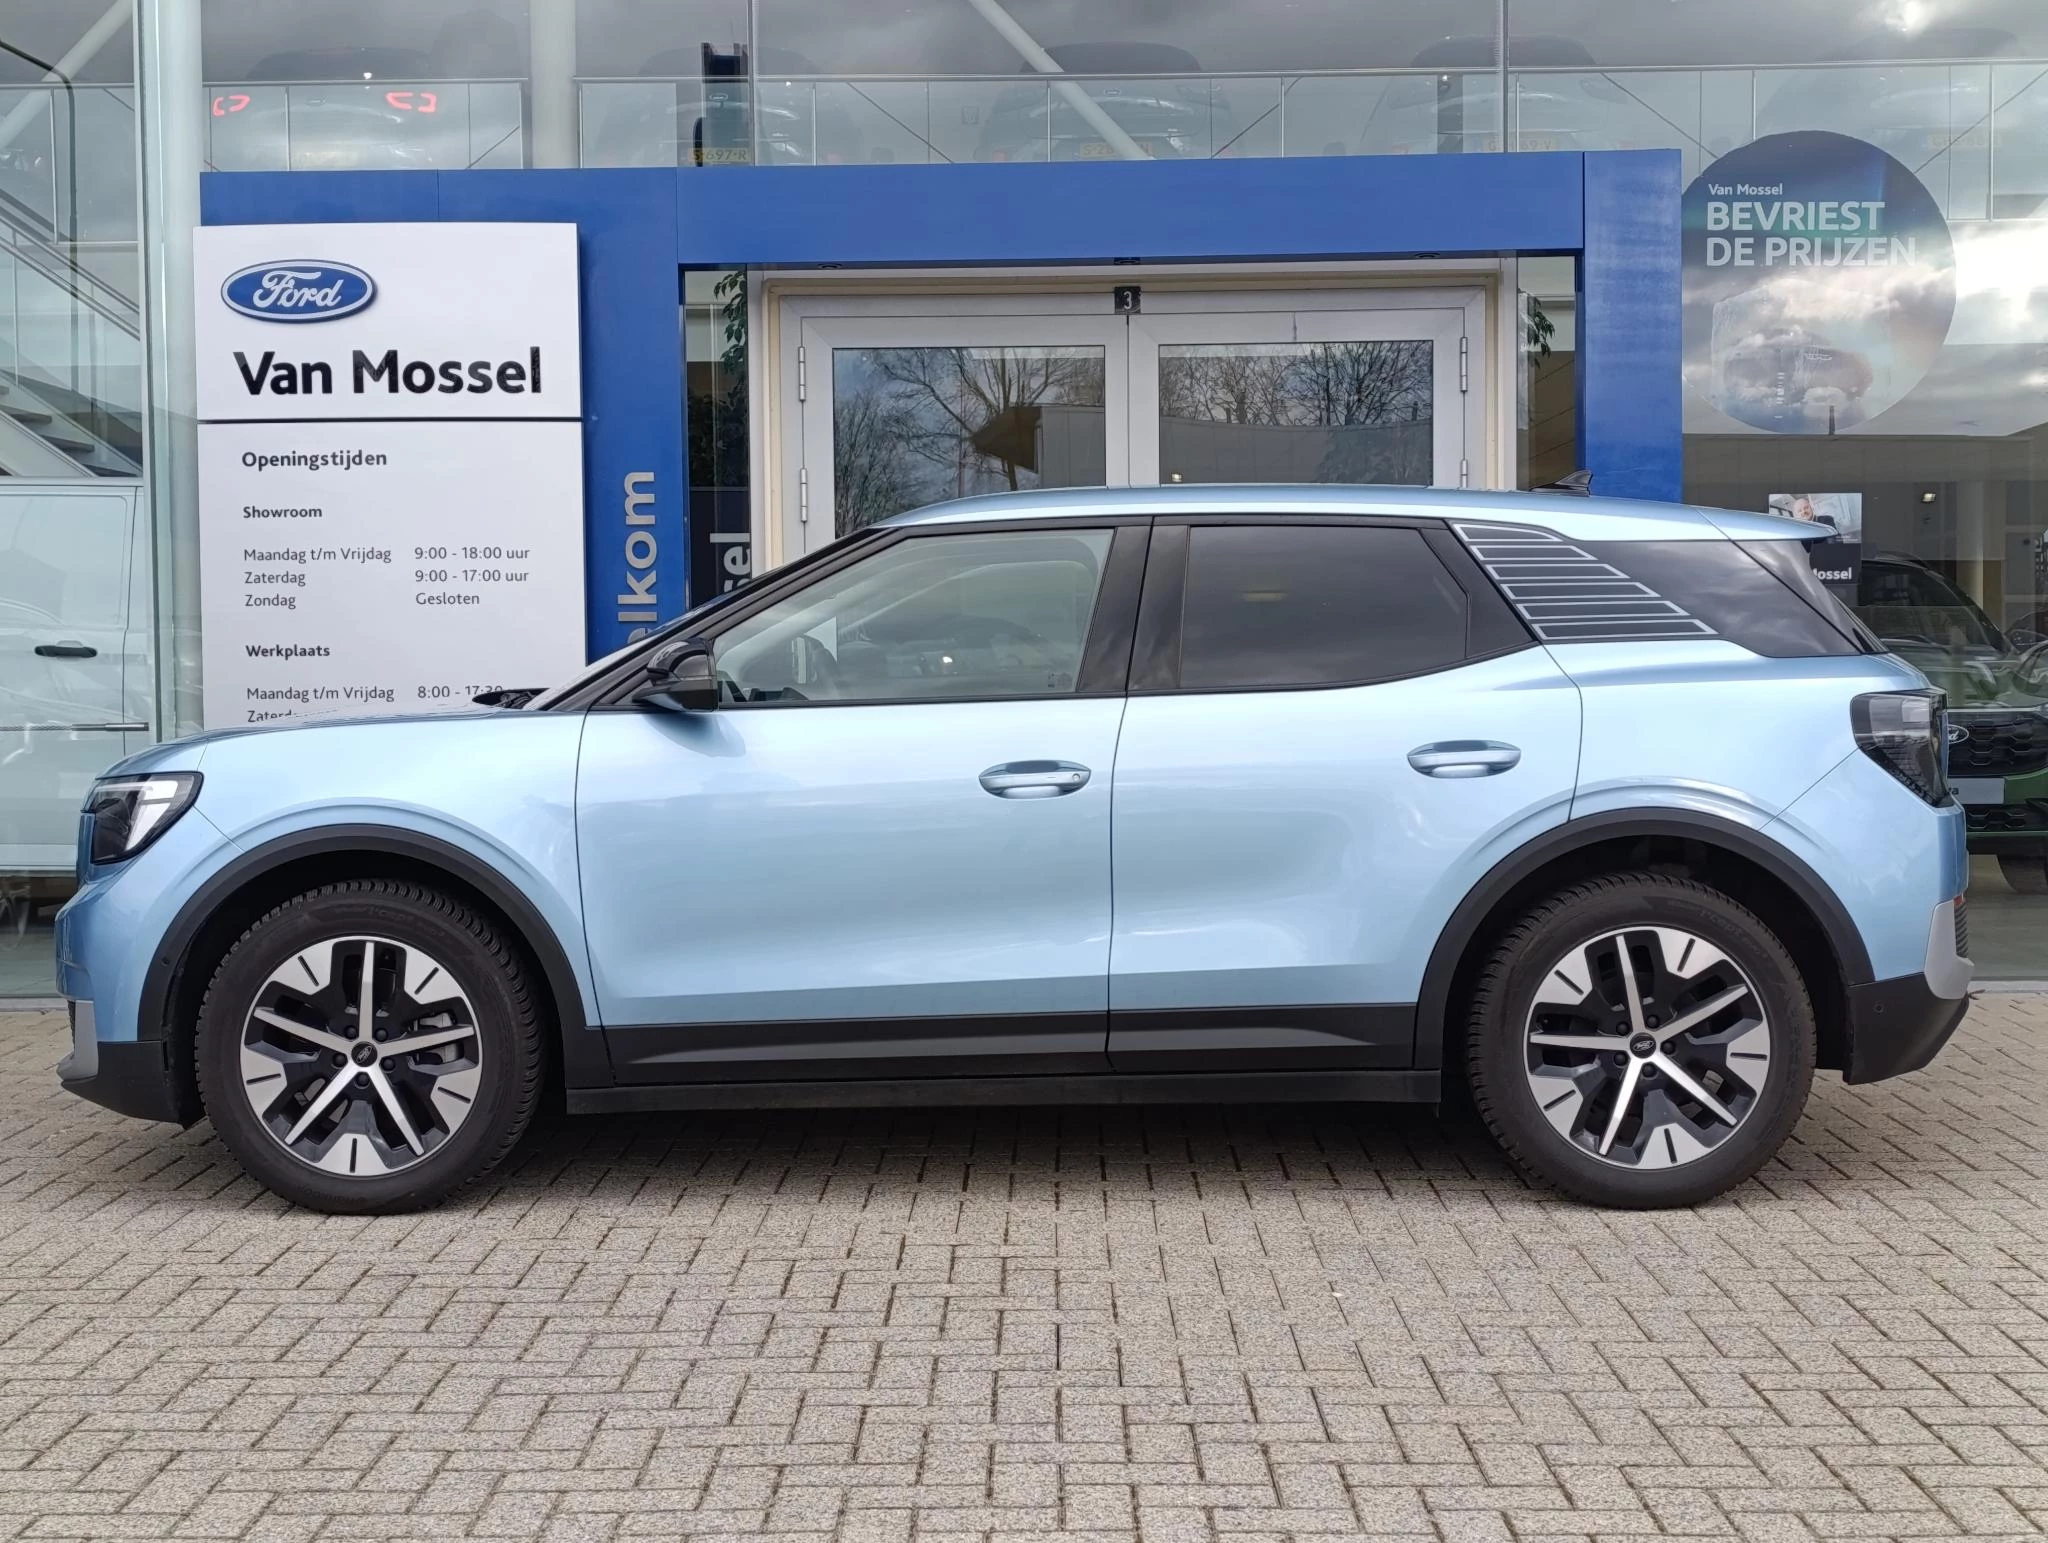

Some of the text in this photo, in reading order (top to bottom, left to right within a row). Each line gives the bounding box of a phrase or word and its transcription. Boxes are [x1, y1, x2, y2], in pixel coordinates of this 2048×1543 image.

[1708, 183, 1783, 196] Van Mossel
[1706, 201, 1886, 232] BEVRIEST
[1706, 237, 1917, 267] DE PRIJZEN
[252, 269, 344, 309] Ford
[1123, 290, 1132, 310] 3
[232, 346, 542, 396] Van Mossel
[241, 449, 388, 472] Openingstijden
[243, 505, 323, 519] Showroom
[243, 546, 392, 565] Maandag t/m Vrijdag
[414, 546, 448, 560] 9:00
[461, 546, 502, 560] 18:00
[506, 549, 531, 560] uur
[244, 570, 306, 587] Zaterdag
[414, 569, 448, 583] 9:00
[462, 569, 501, 582] 17:00
[505, 571, 530, 582] uur
[245, 593, 297, 610] Zondag
[415, 591, 480, 606] Gesloten
[245, 643, 331, 661] Werkplaats
[246, 685, 395, 704] Maandag t/m Vrijdag
[417, 685, 451, 699] 8:00
